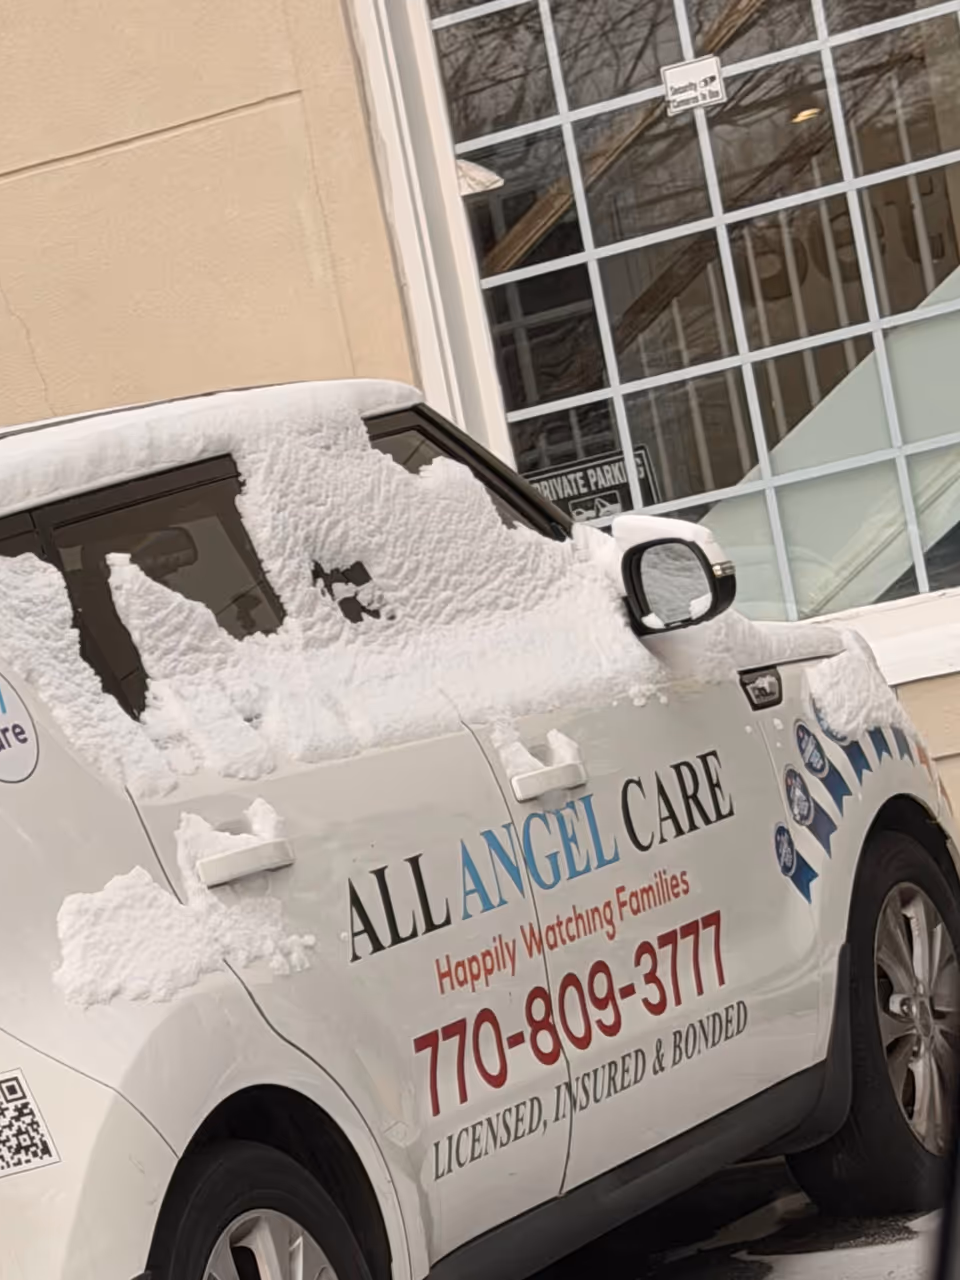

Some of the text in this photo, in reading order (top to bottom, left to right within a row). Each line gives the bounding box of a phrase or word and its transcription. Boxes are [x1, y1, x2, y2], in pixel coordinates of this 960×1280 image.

[586, 458, 645, 490] PARKIG
[347, 853, 452, 963] ALL
[459, 794, 620, 920] ANGEL
[621, 750, 735, 852] CARE
[435, 869, 690, 995] Happily Watching Families
[413, 910, 726, 1117] 770-809-3777
[433, 1000, 749, 1181] LICENSED, INSURED & BONDED
